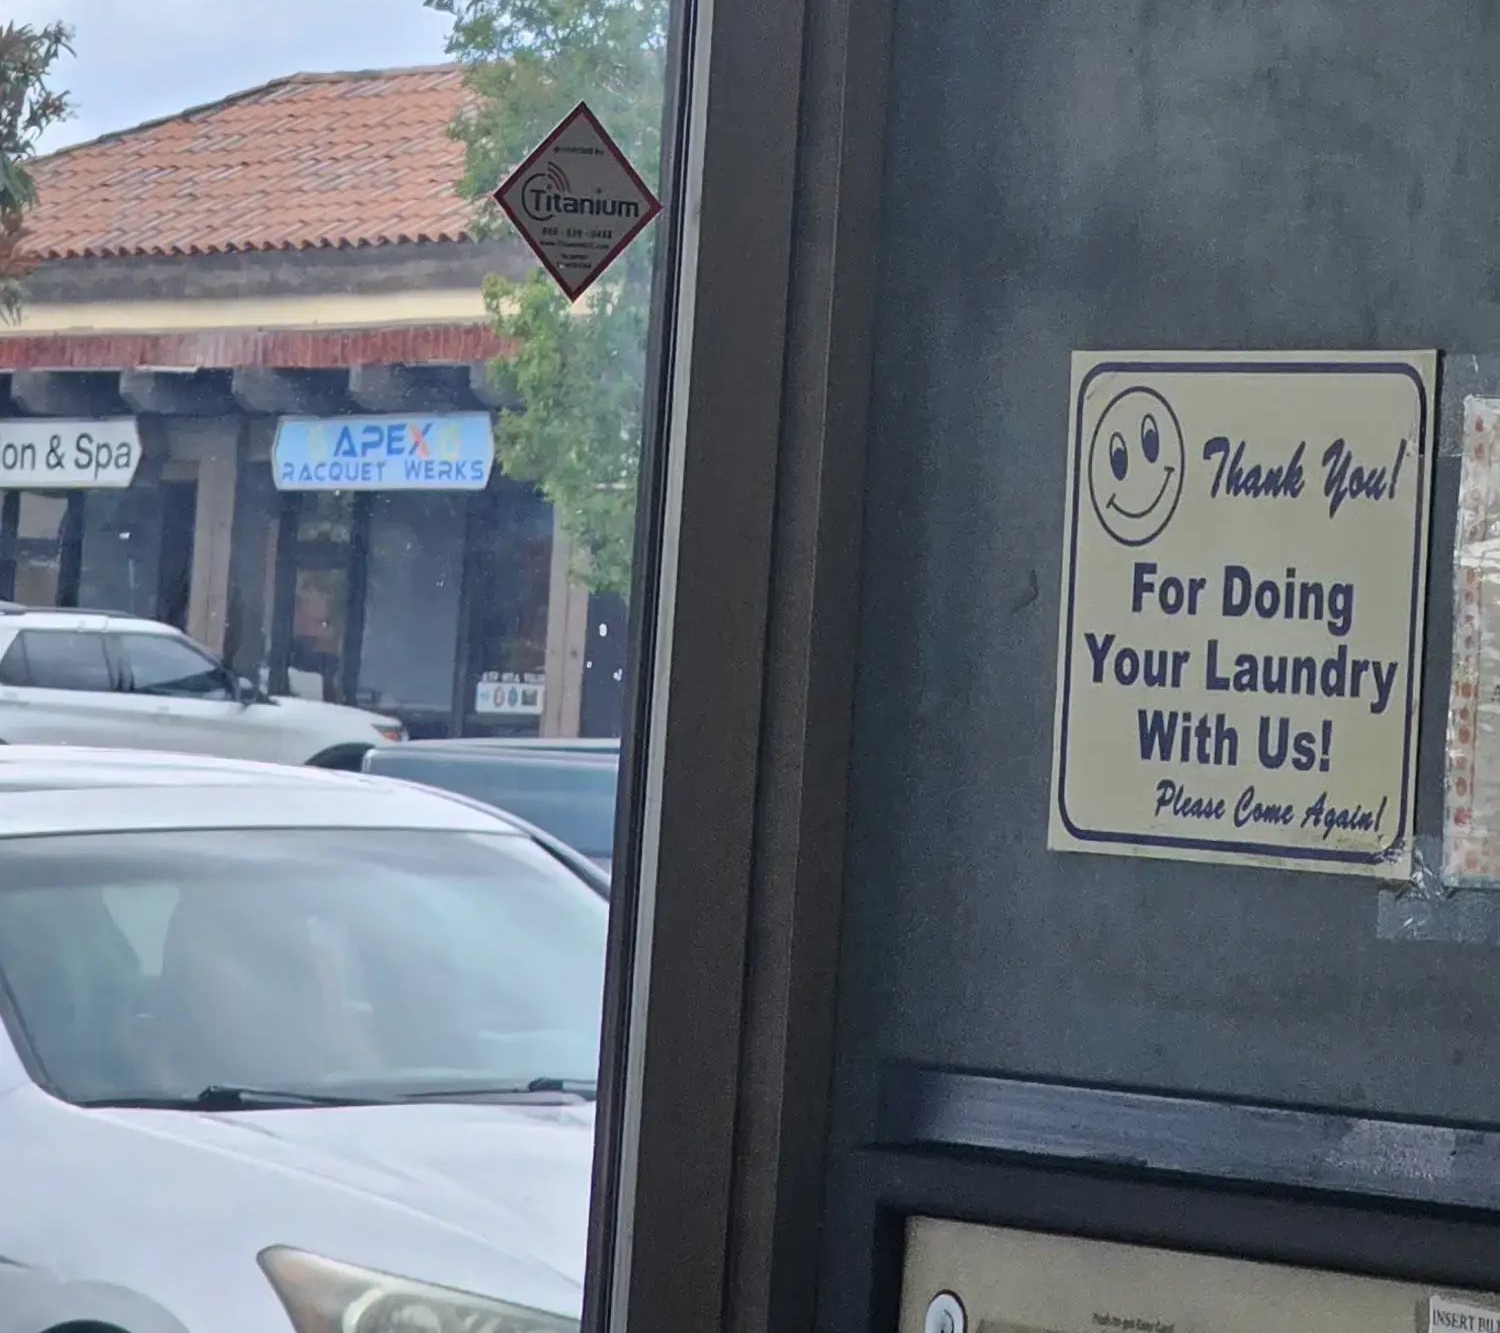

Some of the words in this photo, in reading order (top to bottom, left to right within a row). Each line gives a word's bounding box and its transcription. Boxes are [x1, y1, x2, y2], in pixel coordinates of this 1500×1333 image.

[529, 186, 639, 218] Titanium
[45, 434, 65, 469] &
[74, 432, 132, 481] Spa
[333, 423, 433, 458] APEX
[282, 461, 388, 482] RACQUET
[404, 459, 484, 480] WERKS
[1203, 436, 1306, 500] Thank
[1322, 437, 1407, 519] You!
[1131, 562, 1206, 616] For
[1222, 564, 1355, 637] Doing
[1083, 632, 1190, 688] Your
[1205, 639, 1398, 715] Laundry
[1137, 709, 1239, 766] With
[1257, 716, 1334, 773] Us!
[1155, 779, 1227, 819] Please
[1233, 785, 1294, 828] Come
[1301, 793, 1388, 840] Again!
[1433, 1309, 1475, 1331] INSERT
